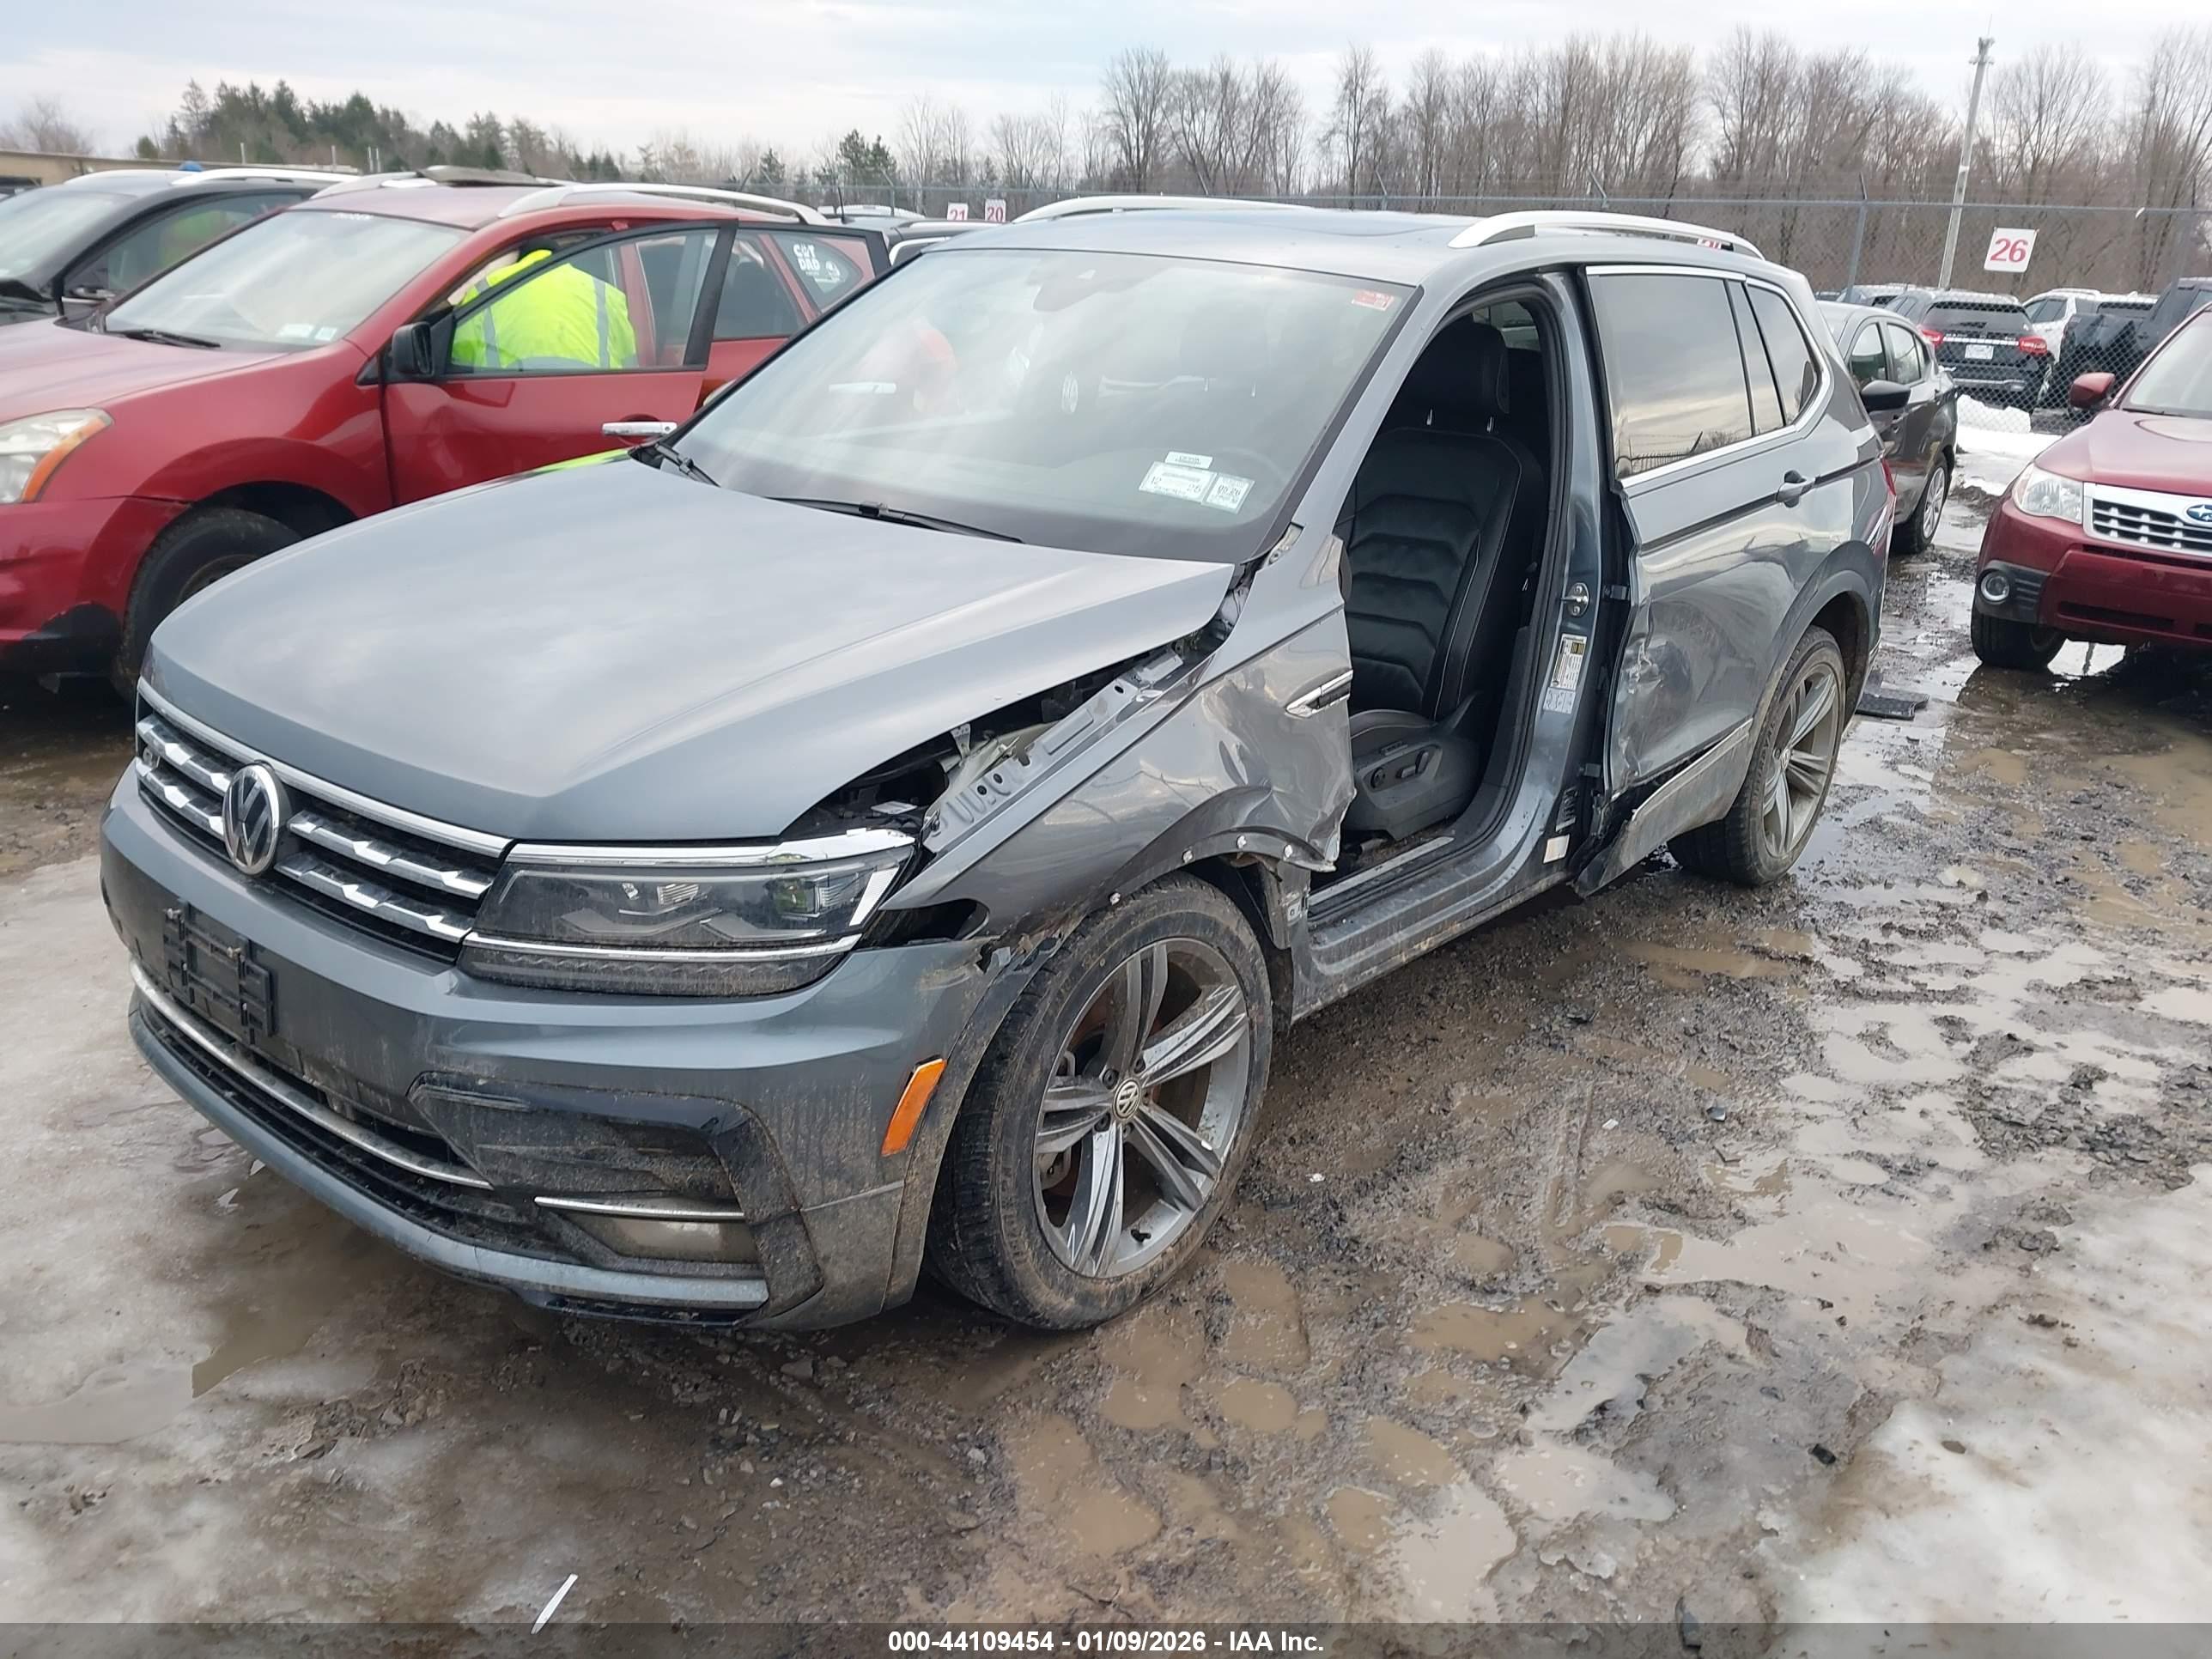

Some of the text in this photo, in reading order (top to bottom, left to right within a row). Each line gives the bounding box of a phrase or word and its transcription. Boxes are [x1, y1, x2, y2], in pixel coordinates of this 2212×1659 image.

[950, 209, 965, 220] 21
[988, 206, 1004, 222] 20
[1990, 238, 2028, 263] 26
[798, 258, 820, 270] DAD
